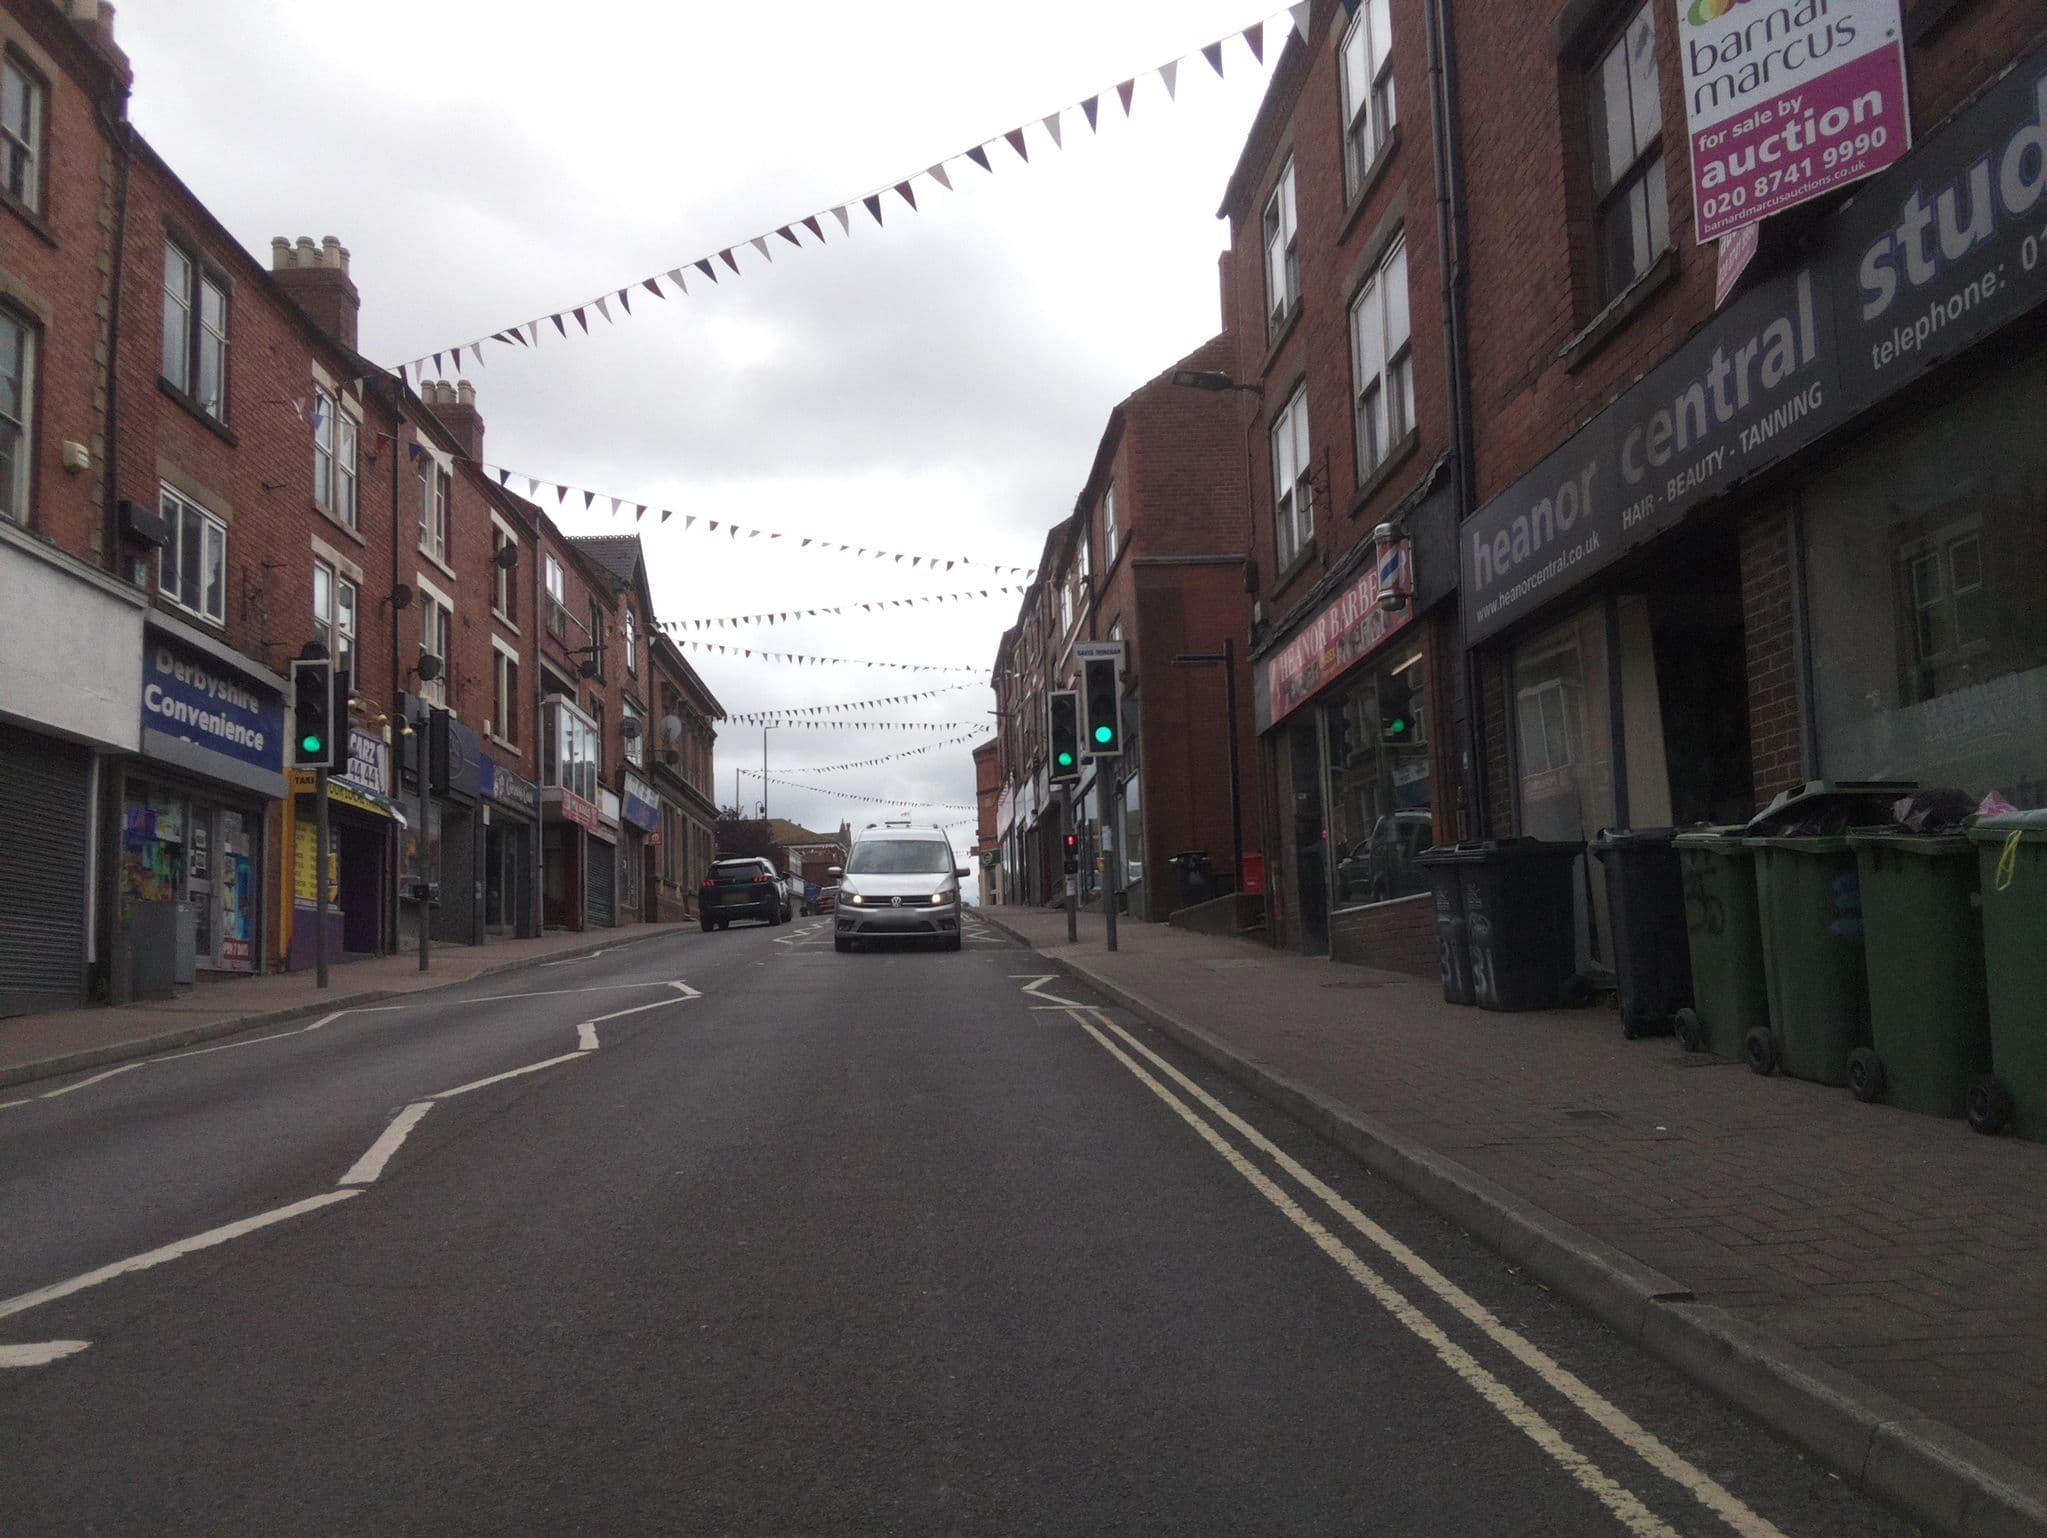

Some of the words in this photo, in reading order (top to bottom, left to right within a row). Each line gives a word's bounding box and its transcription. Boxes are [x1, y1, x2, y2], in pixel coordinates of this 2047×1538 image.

[1694, 15, 1857, 114] marcus
[1698, 130, 1727, 152] for
[1732, 111, 1773, 138] sale
[1778, 96, 1802, 117] by
[1701, 90, 1884, 189] auction
[1703, 187, 1746, 219] 020
[1754, 157, 1812, 198] 8741
[1823, 126, 1887, 169] 9990
[1703, 160, 1866, 233] barnardmarcusauctions.co.uk
[1871, 263, 2006, 370] telephone:
[2022, 225, 2047, 271] 0
[1473, 459, 1597, 591] heanor
[1621, 269, 1817, 486] central
[1622, 494, 1656, 531] HAIR
[1666, 445, 1725, 503] BEAUTY
[1739, 382, 1823, 454] TANNING
[1476, 529, 1601, 623] www.heanorcentral.co.uk
[1279, 618, 1328, 683] HEANOR
[1330, 572, 1379, 638] BARBE
[144, 683, 265, 751] Convenience
[156, 648, 259, 714] Derbyshire
